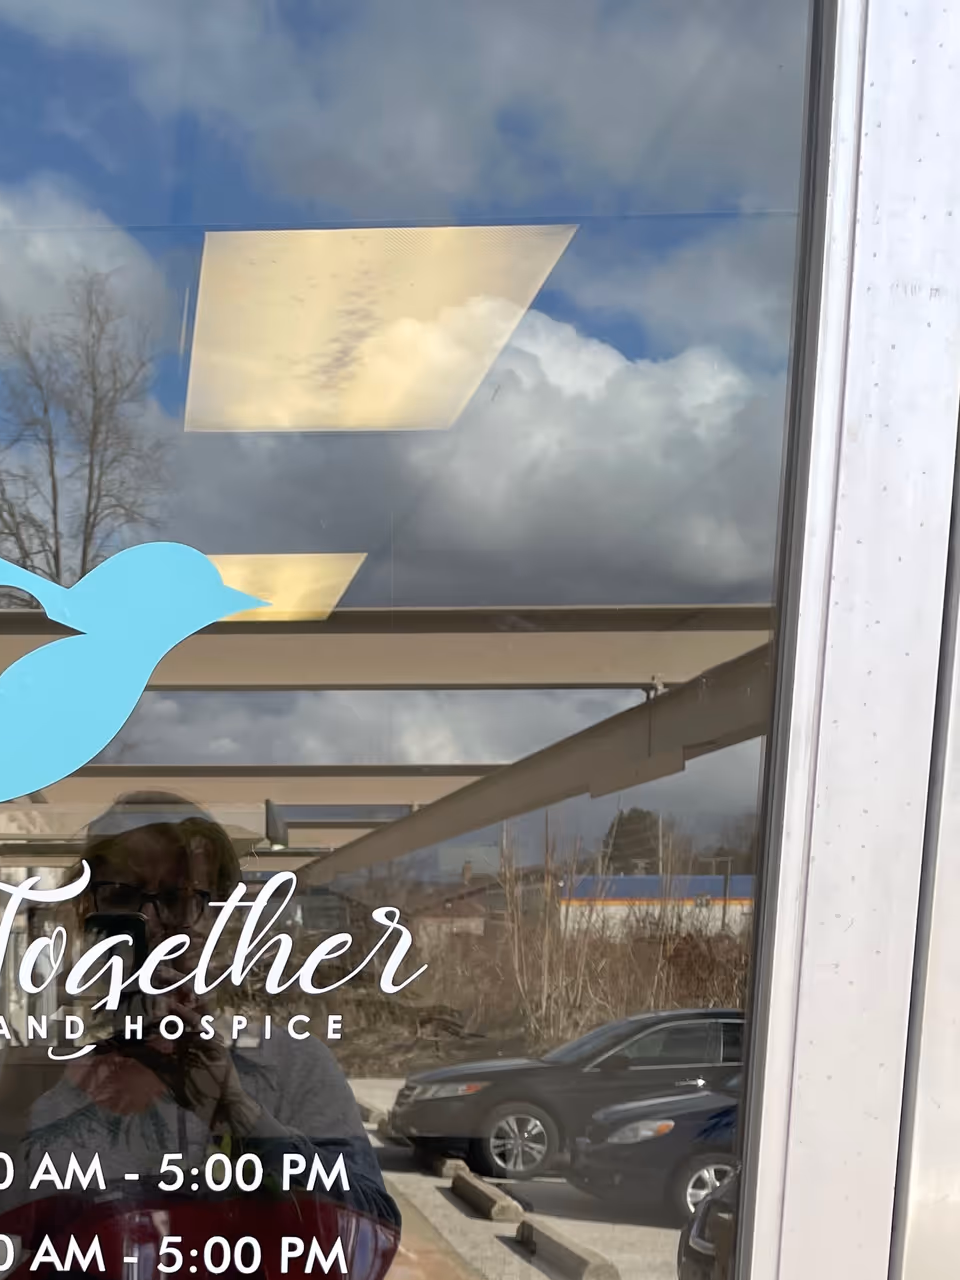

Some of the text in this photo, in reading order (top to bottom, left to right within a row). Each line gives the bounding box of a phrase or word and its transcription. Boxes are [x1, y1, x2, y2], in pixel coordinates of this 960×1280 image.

[125, 1014, 342, 1040] HOSPICE
[29, 1151, 106, 1192] AM
[158, 1153, 263, 1192] 5:00
[282, 1152, 350, 1192] PM
[29, 1233, 106, 1273] AM
[123, 1256, 138, 1264] -
[157, 1236, 261, 1274] 5:00
[281, 1236, 348, 1274] PM
